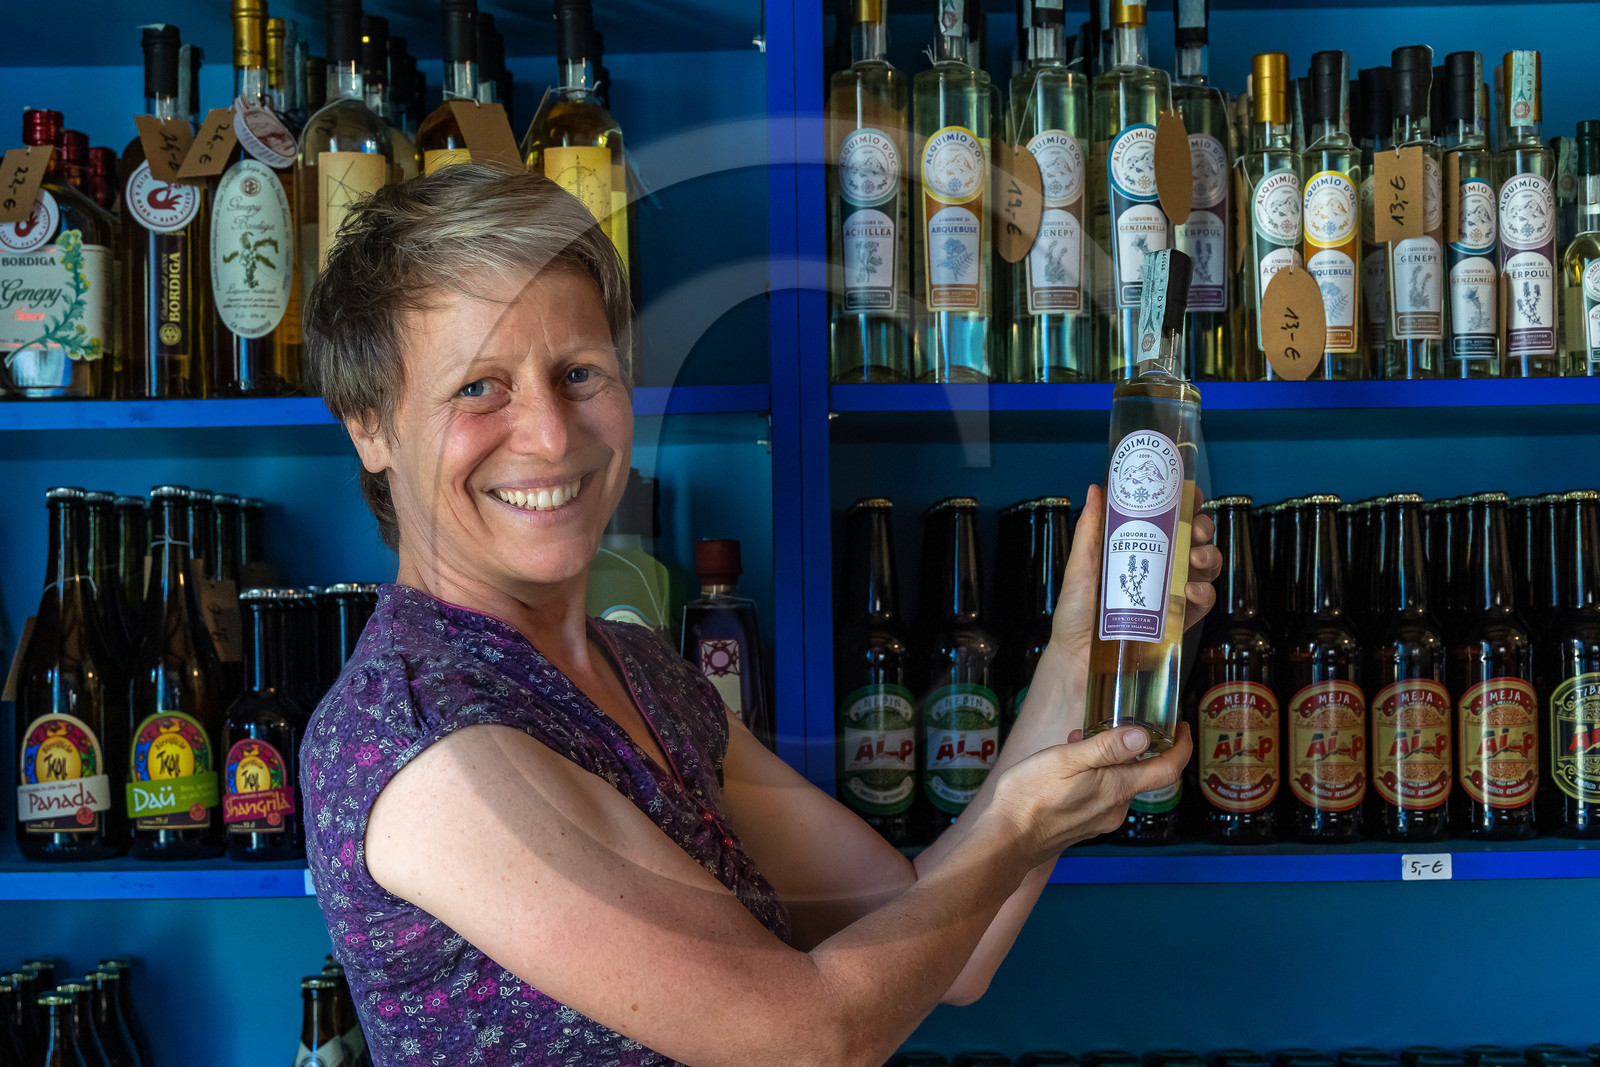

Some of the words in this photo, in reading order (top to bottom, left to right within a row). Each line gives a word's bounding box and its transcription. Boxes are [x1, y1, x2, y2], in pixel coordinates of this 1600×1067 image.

[845, 228, 892, 237] ACHILLEA
[931, 226, 977, 234] ARQUEBUSE
[2, 257, 56, 266] BORDIGA
[1401, 255, 1438, 263] GENEPY
[0, 279, 62, 310] Genepy
[168, 252, 181, 322] BORDIGA
[1224, 693, 1256, 705] MEJA
[1318, 692, 1350, 705] MEJA
[1401, 692, 1433, 703] MEJA
[1490, 690, 1521, 702] MEJA
[854, 734, 914, 762] ALP
[936, 733, 995, 762] ALP
[1213, 732, 1273, 760] ALP
[1306, 731, 1364, 760] ALP
[1388, 730, 1448, 758] ALP
[1476, 728, 1535, 758] ALP
[29, 782, 97, 814] Panada
[133, 786, 176, 812] Daü
